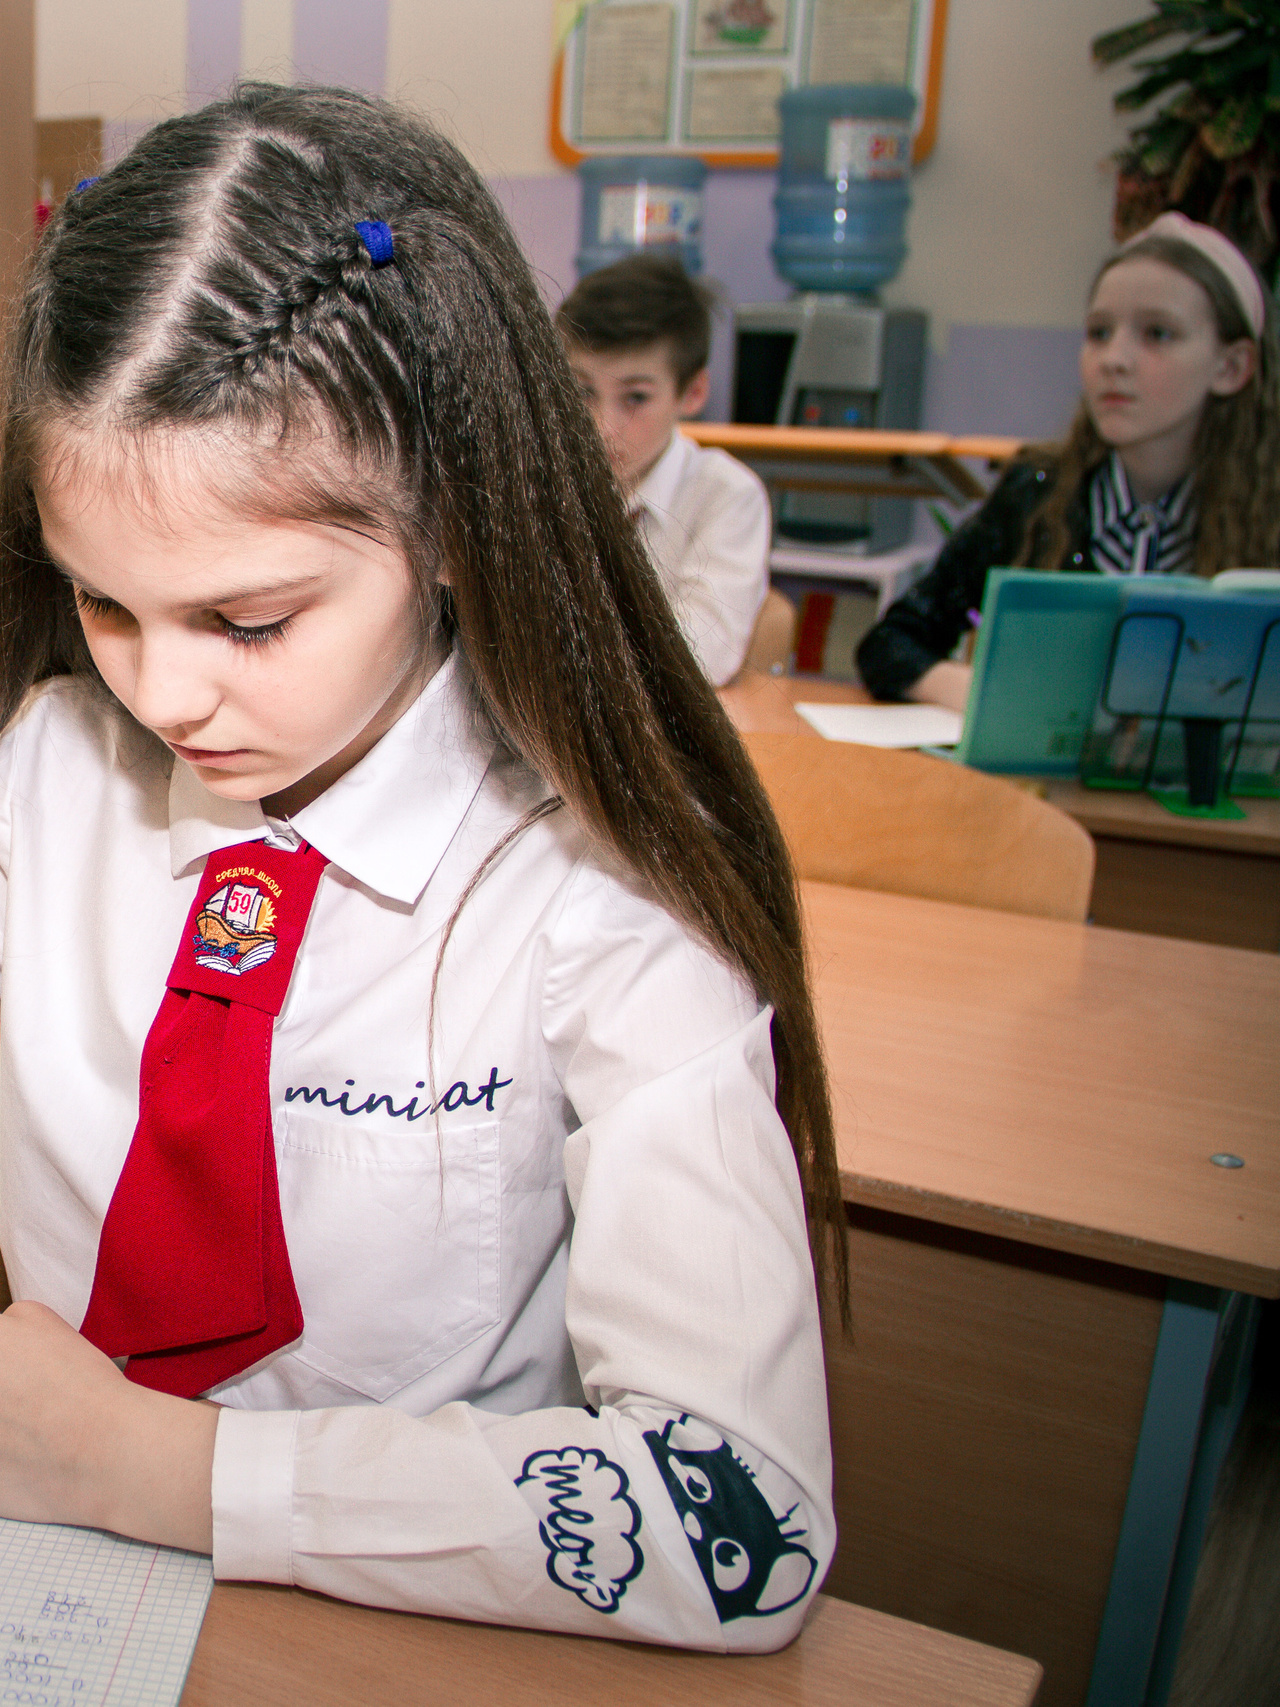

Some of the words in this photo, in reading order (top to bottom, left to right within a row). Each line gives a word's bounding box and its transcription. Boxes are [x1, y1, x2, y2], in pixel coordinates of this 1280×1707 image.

[254, 870, 283, 898] ШКОЛА
[228, 890, 252, 914] 59
[284, 1066, 514, 1122] miniat
